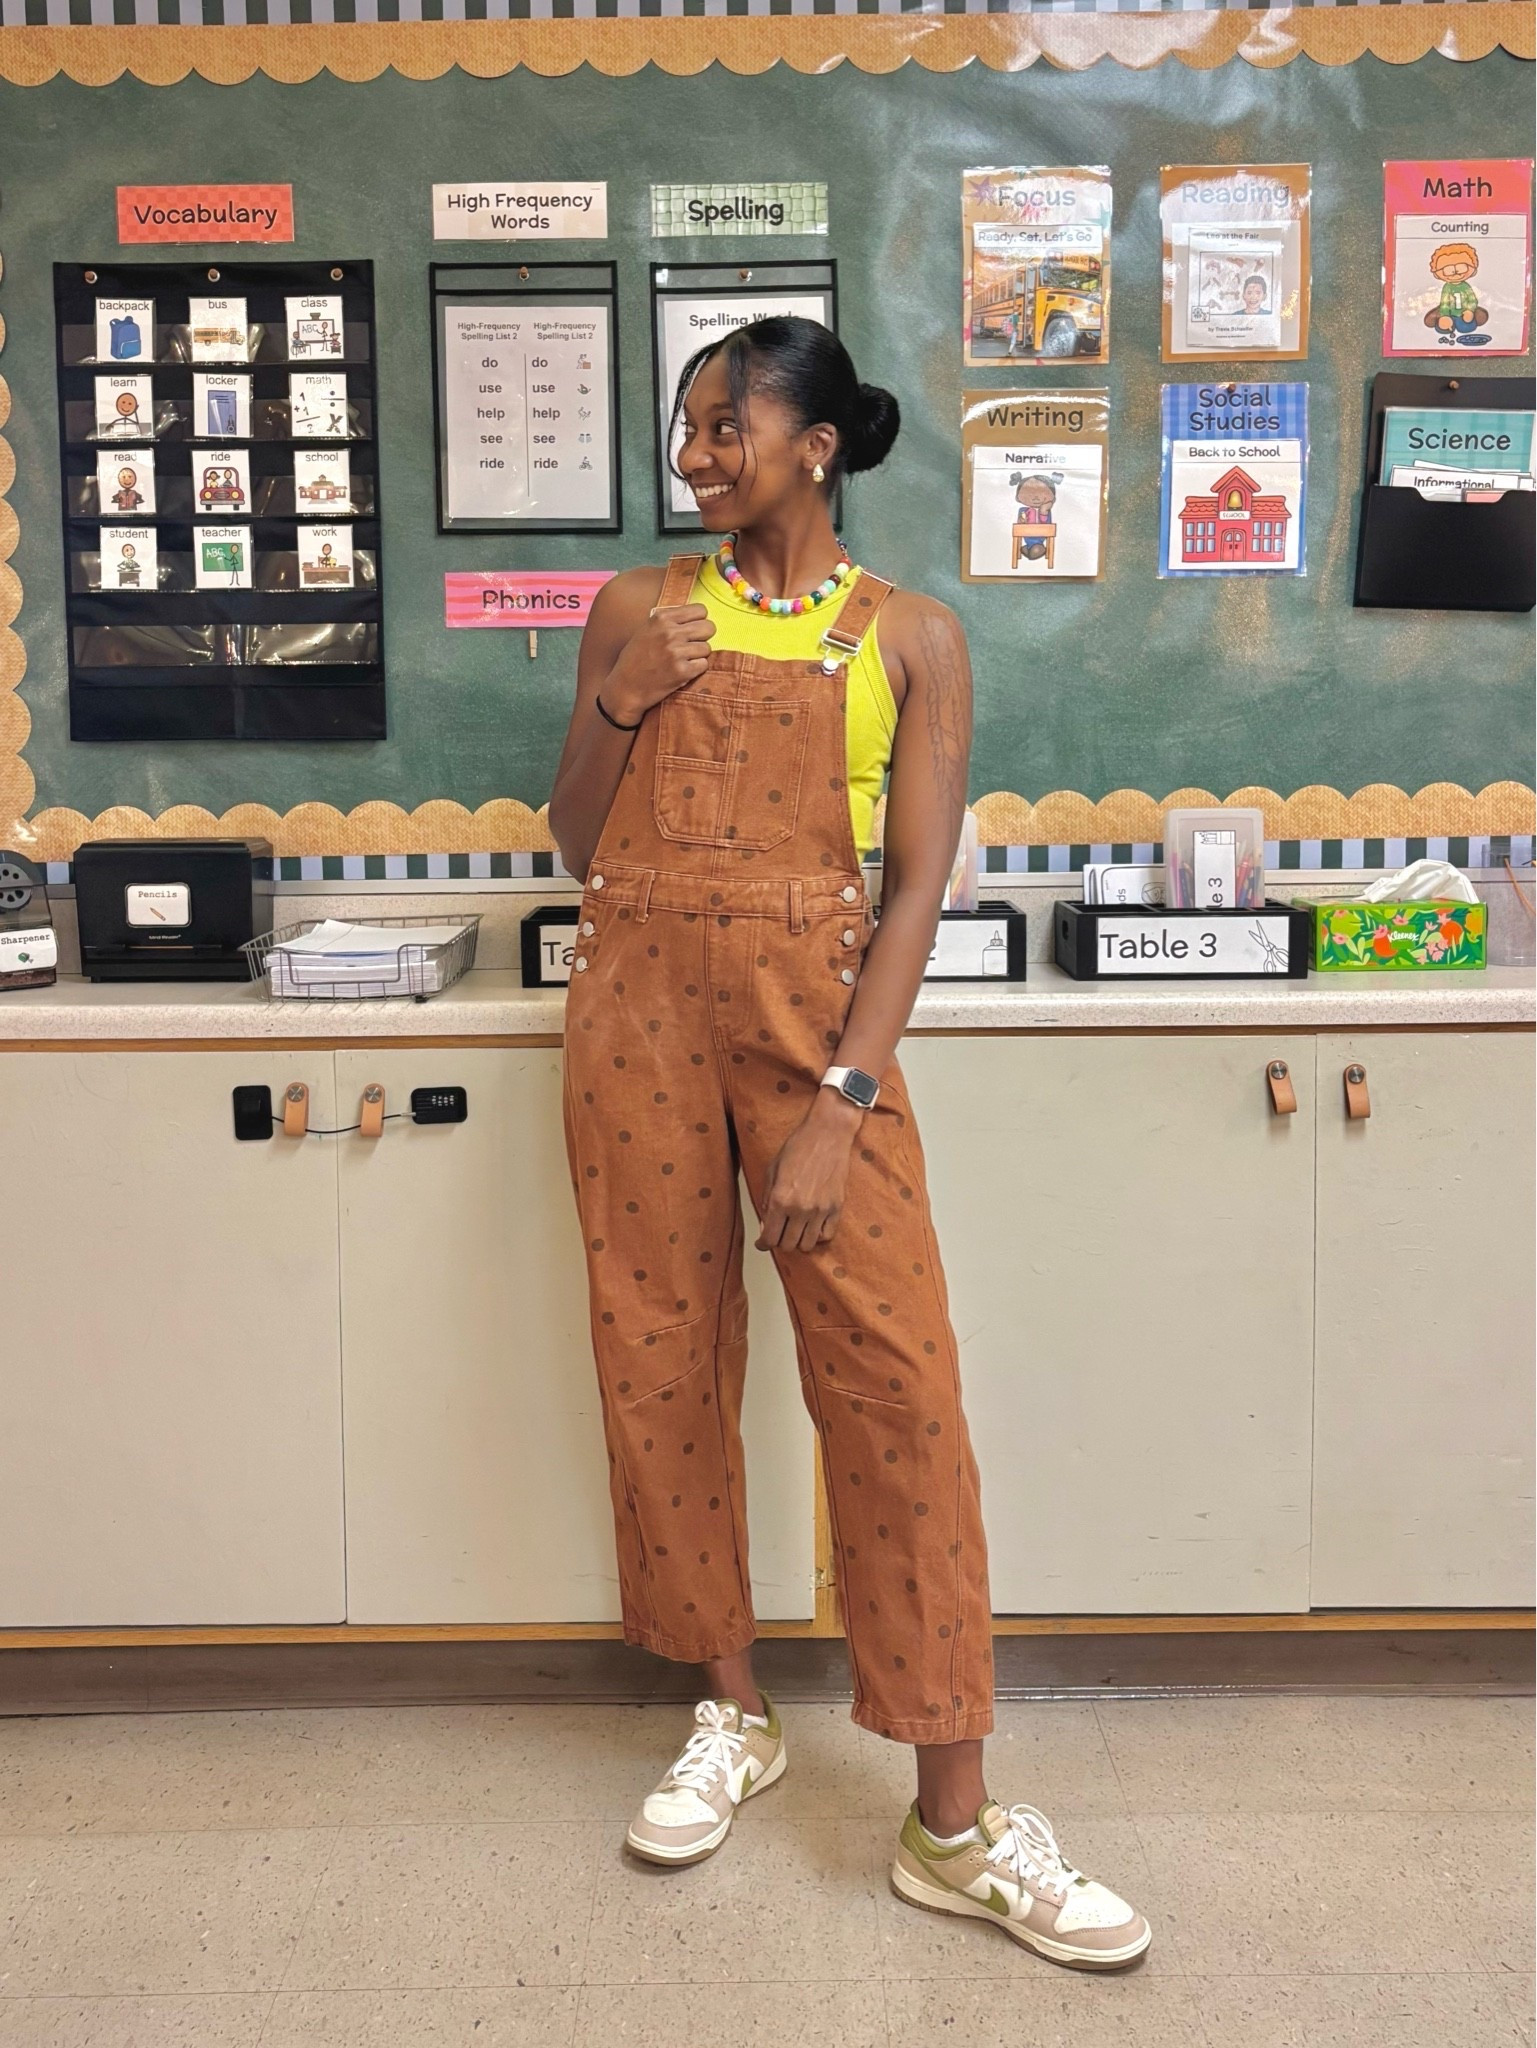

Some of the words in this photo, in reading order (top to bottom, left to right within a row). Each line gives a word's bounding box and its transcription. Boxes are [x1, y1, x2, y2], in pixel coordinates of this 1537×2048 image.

[1423, 176, 1493, 198] Math
[998, 185, 1076, 207] Focus
[1182, 183, 1290, 208] Reading
[447, 193, 490, 212] High
[496, 193, 593, 213] Frequency
[133, 200, 278, 230] Vocabulary
[688, 196, 785, 227] Spelling
[490, 213, 551, 230] Words
[1430, 221, 1490, 235] Counting
[1044, 231, 1074, 242] Let's
[1075, 231, 1092, 242] Go
[1231, 232, 1244, 240] the
[1245, 232, 1259, 240] Fair
[99, 300, 150, 312] backpack
[208, 299, 228, 309] bus
[300, 298, 328, 308] class
[457, 322, 521, 331] High-Frequency
[533, 322, 597, 331] High-Frequency
[689, 312, 749, 330] Spelling
[461, 332, 494, 341] Spelling
[495, 332, 511, 340] List
[512, 332, 518, 340] 2
[537, 332, 570, 341] Spelling
[571, 332, 587, 340] List
[588, 332, 594, 340] 2
[481, 357, 499, 368] do
[531, 357, 549, 368] do
[110, 377, 137, 388] learn
[205, 375, 238, 386] locker
[305, 375, 332, 385] math
[478, 384, 503, 394] use
[532, 384, 556, 394] use
[1199, 384, 1272, 408] Social
[477, 407, 506, 421] help
[532, 407, 561, 421] help
[987, 406, 1084, 433] Writing
[1189, 411, 1281, 431] Studies
[480, 434, 503, 444] see
[533, 434, 556, 444] see
[1408, 427, 1511, 451] Science
[210, 451, 231, 461] ride
[305, 452, 339, 462] school
[1188, 446, 1220, 458] Back
[1222, 447, 1236, 457] to
[1238, 445, 1281, 458] School
[479, 457, 505, 469] ride
[533, 457, 559, 469] ride
[1005, 453, 1067, 464] Narrative
[1413, 476, 1495, 489] Informational
[109, 528, 149, 539] student
[201, 527, 242, 538] teacher
[312, 527, 338, 537] work
[482, 589, 581, 610] Phonics
[1207, 877, 1223, 888] 3
[137, 890, 178, 898] Pencils
[0, 933, 51, 946] Sharpener
[1387, 930, 1420, 943] Kleenex
[1099, 928, 1189, 959] Table
[1198, 932, 1218, 958] 3
